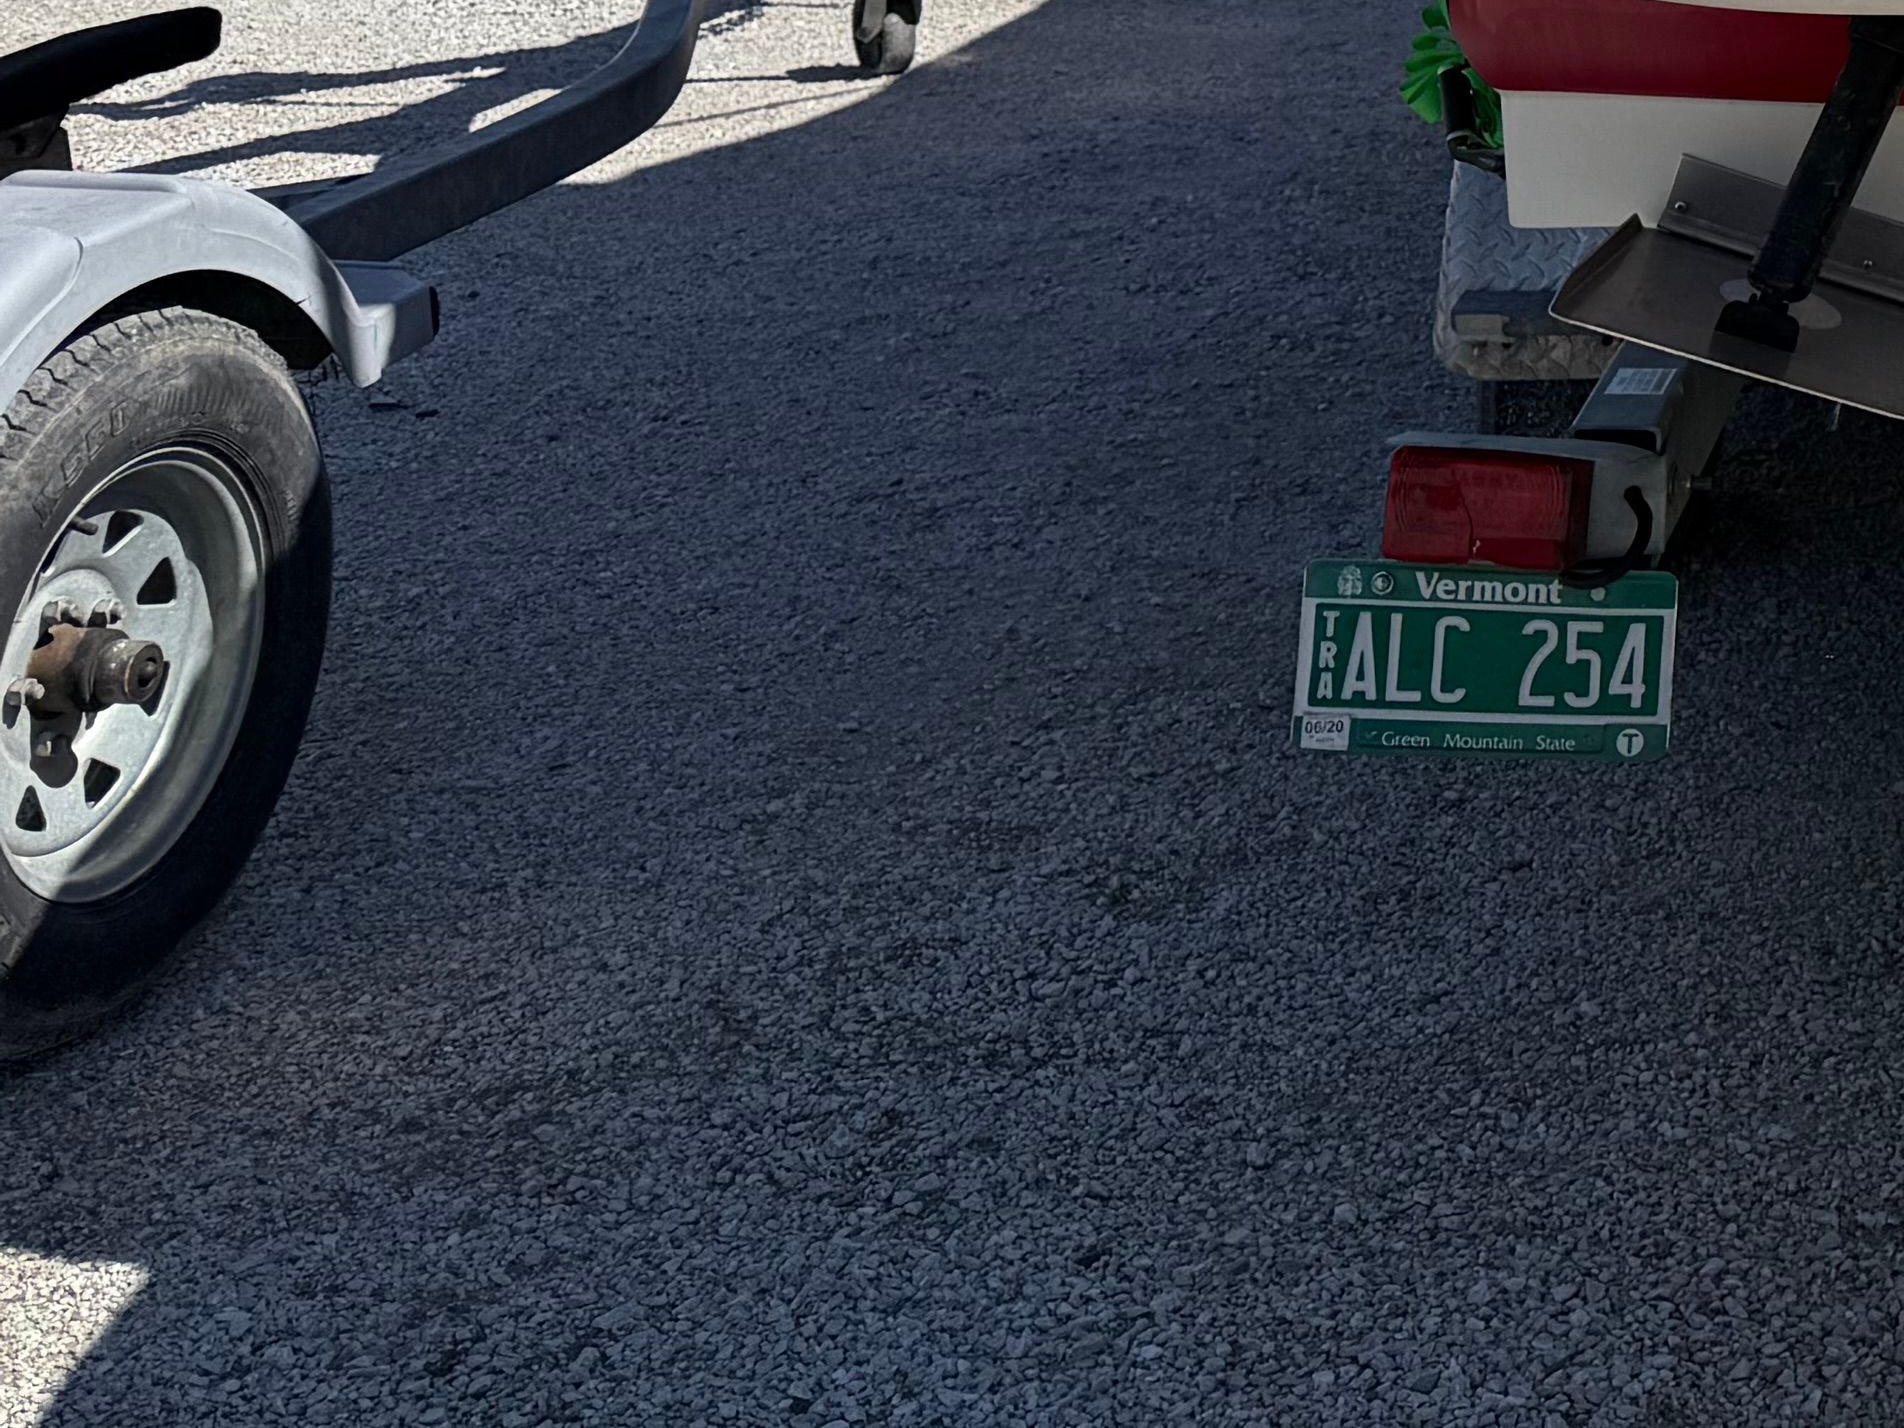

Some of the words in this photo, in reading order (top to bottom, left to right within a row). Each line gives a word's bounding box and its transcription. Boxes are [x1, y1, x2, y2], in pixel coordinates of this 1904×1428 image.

[1415, 571, 1563, 604] Vermont
[1340, 611, 1471, 704] ALC
[1518, 619, 1646, 709] 254
[1382, 730, 1431, 748] Green
[1443, 733, 1524, 751] Mountain
[1535, 734, 1576, 752] State
[1621, 732, 1640, 755] T
